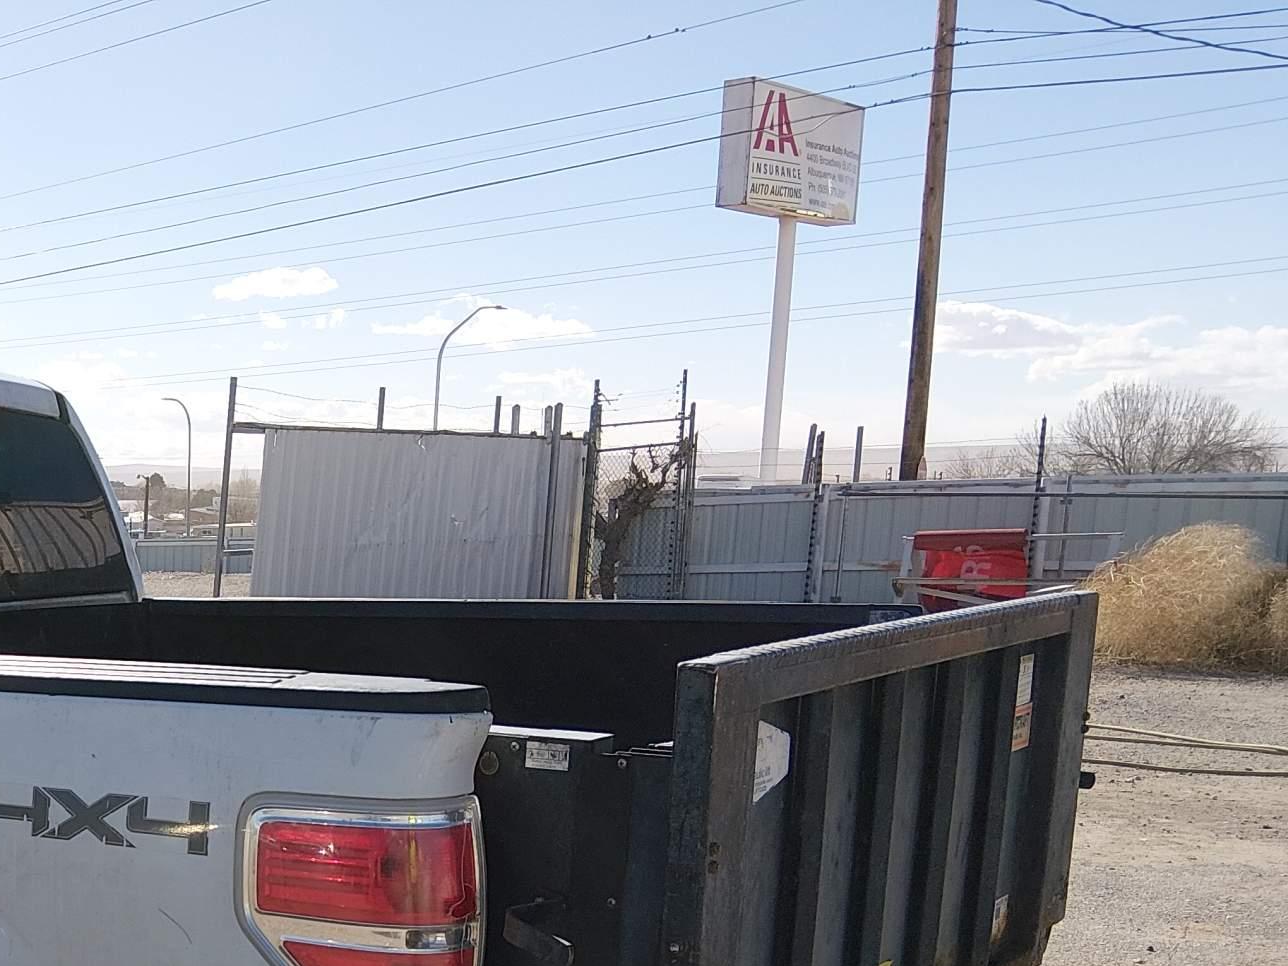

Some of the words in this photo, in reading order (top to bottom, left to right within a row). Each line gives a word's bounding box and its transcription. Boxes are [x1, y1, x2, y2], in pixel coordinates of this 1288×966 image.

[752, 162, 801, 180] INSURANCE
[750, 182, 769, 196] AUTO
[770, 184, 802, 199] AUCTIONS
